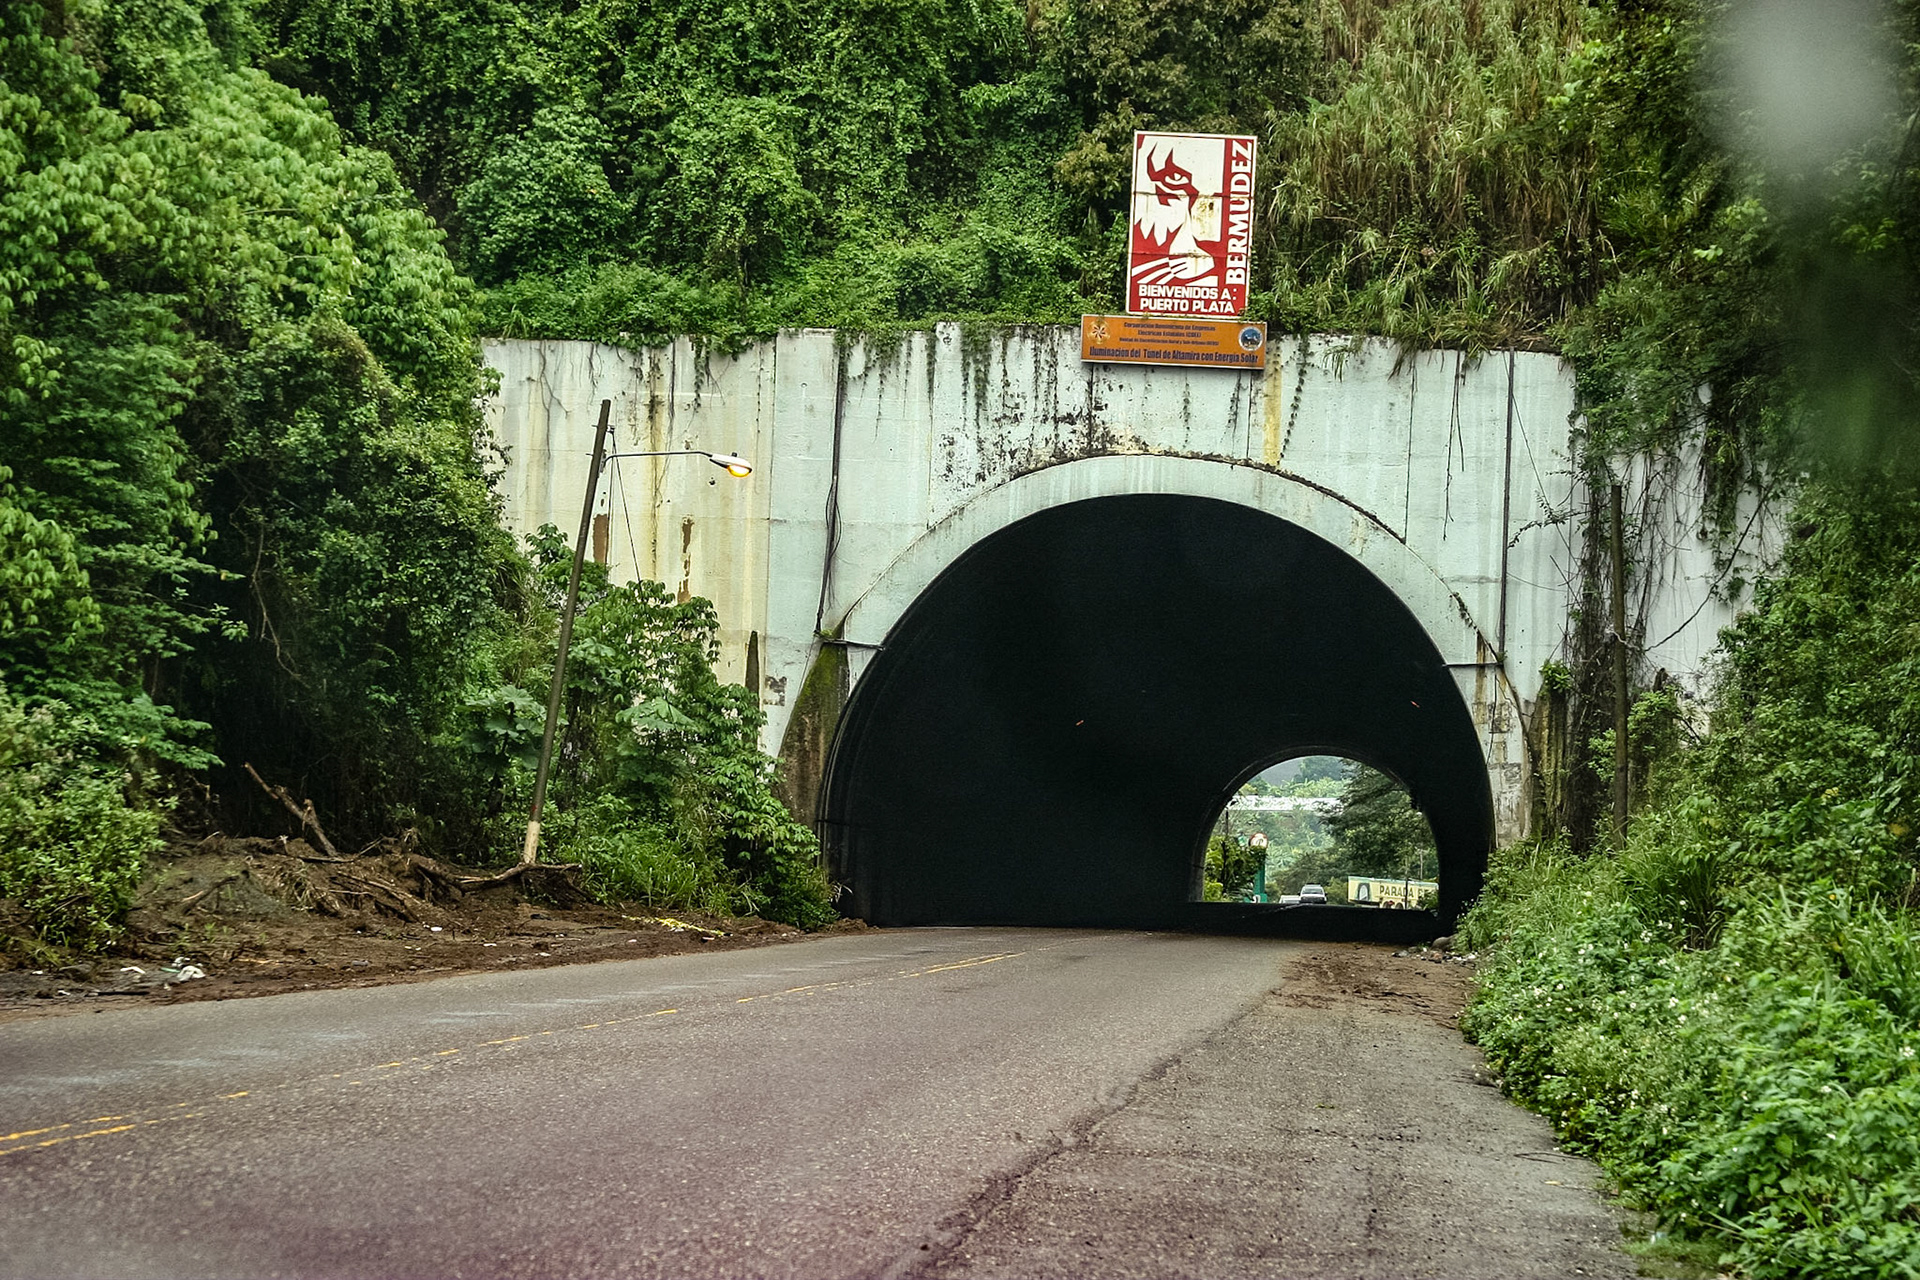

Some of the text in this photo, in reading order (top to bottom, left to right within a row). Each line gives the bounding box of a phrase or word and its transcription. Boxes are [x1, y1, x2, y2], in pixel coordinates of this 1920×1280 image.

[1225, 140, 1253, 285] BERMUDEZ
[1138, 284, 1237, 301] BIENVENIDOS A:
[1140, 298, 1235, 314] PUERTO PLATA
[1130, 348, 1141, 358] del
[1163, 350, 1172, 359] de
[1172, 349, 1200, 360] Altamira
[1201, 352, 1214, 361] con
[1240, 352, 1259, 363] Solar
